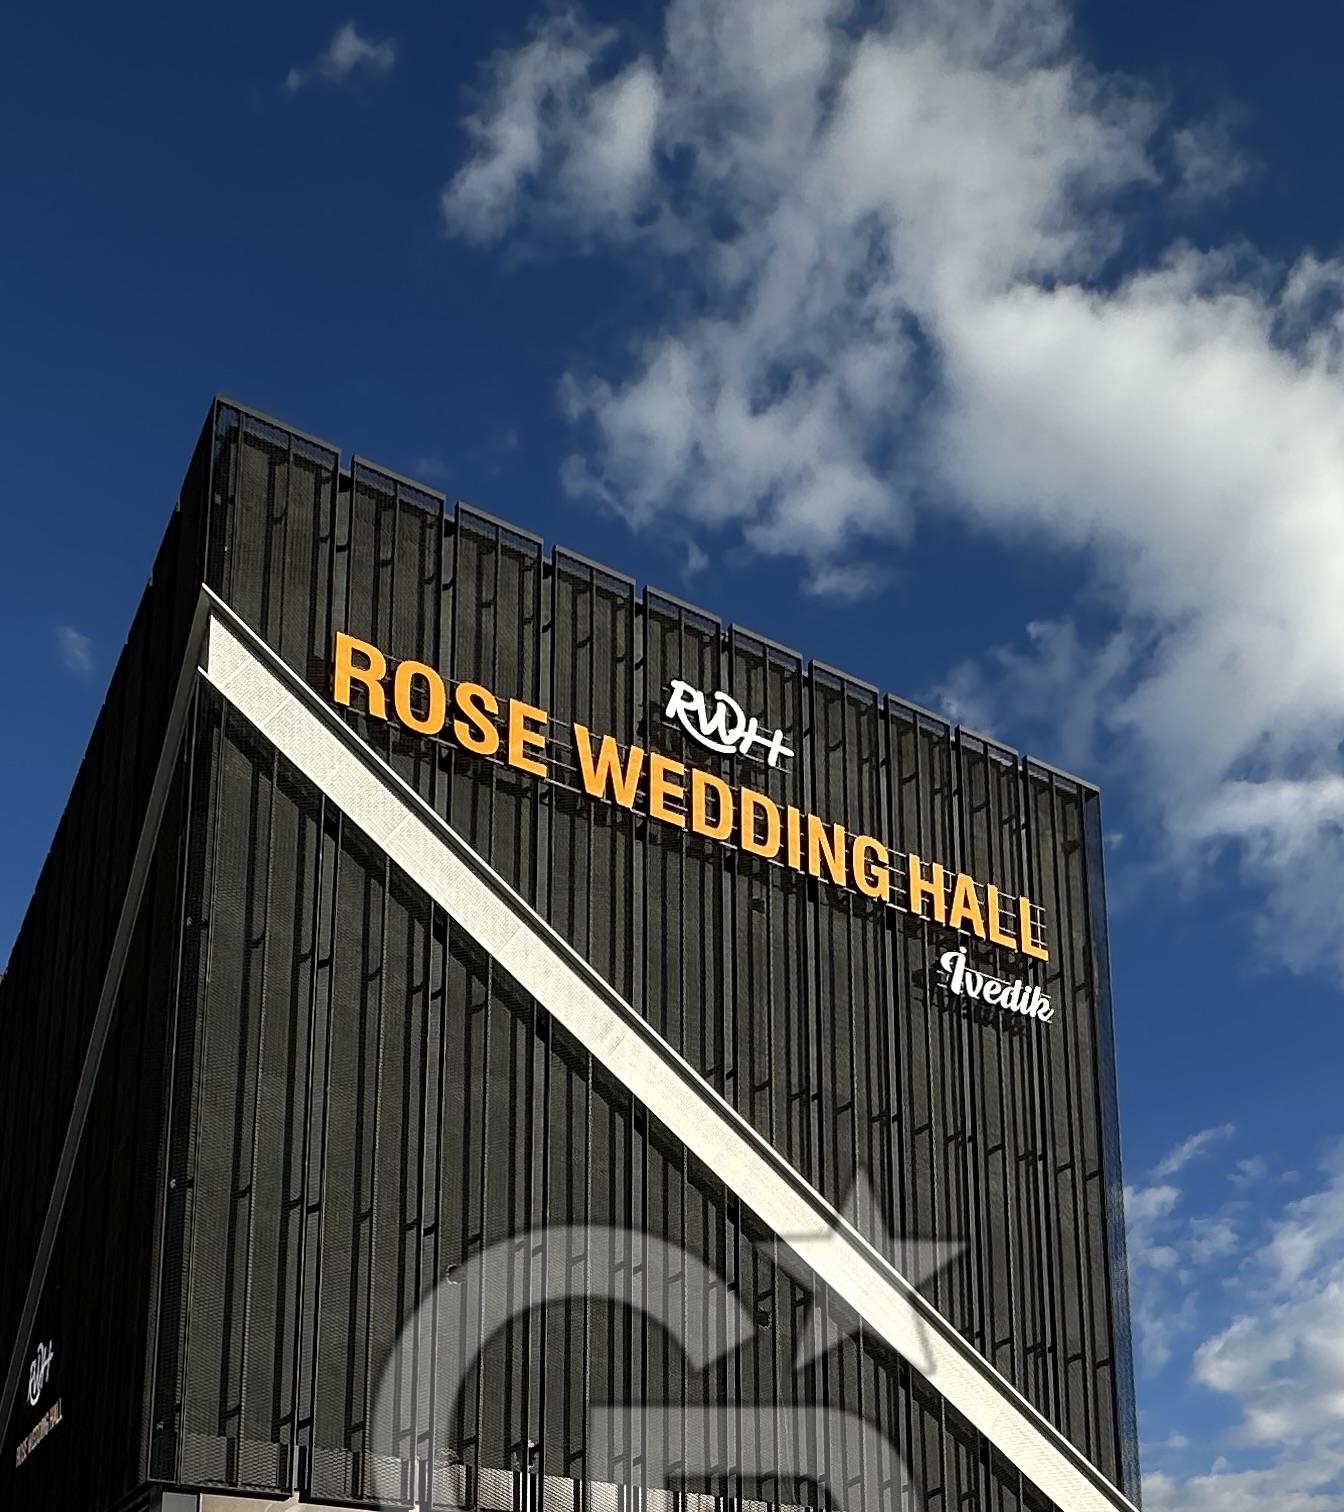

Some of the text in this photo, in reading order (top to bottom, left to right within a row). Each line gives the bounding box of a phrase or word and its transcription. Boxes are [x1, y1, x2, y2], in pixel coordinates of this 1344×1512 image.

[332, 631, 1051, 962] ROSE WEDDING HALL
[940, 946, 1054, 1023] İvedik
